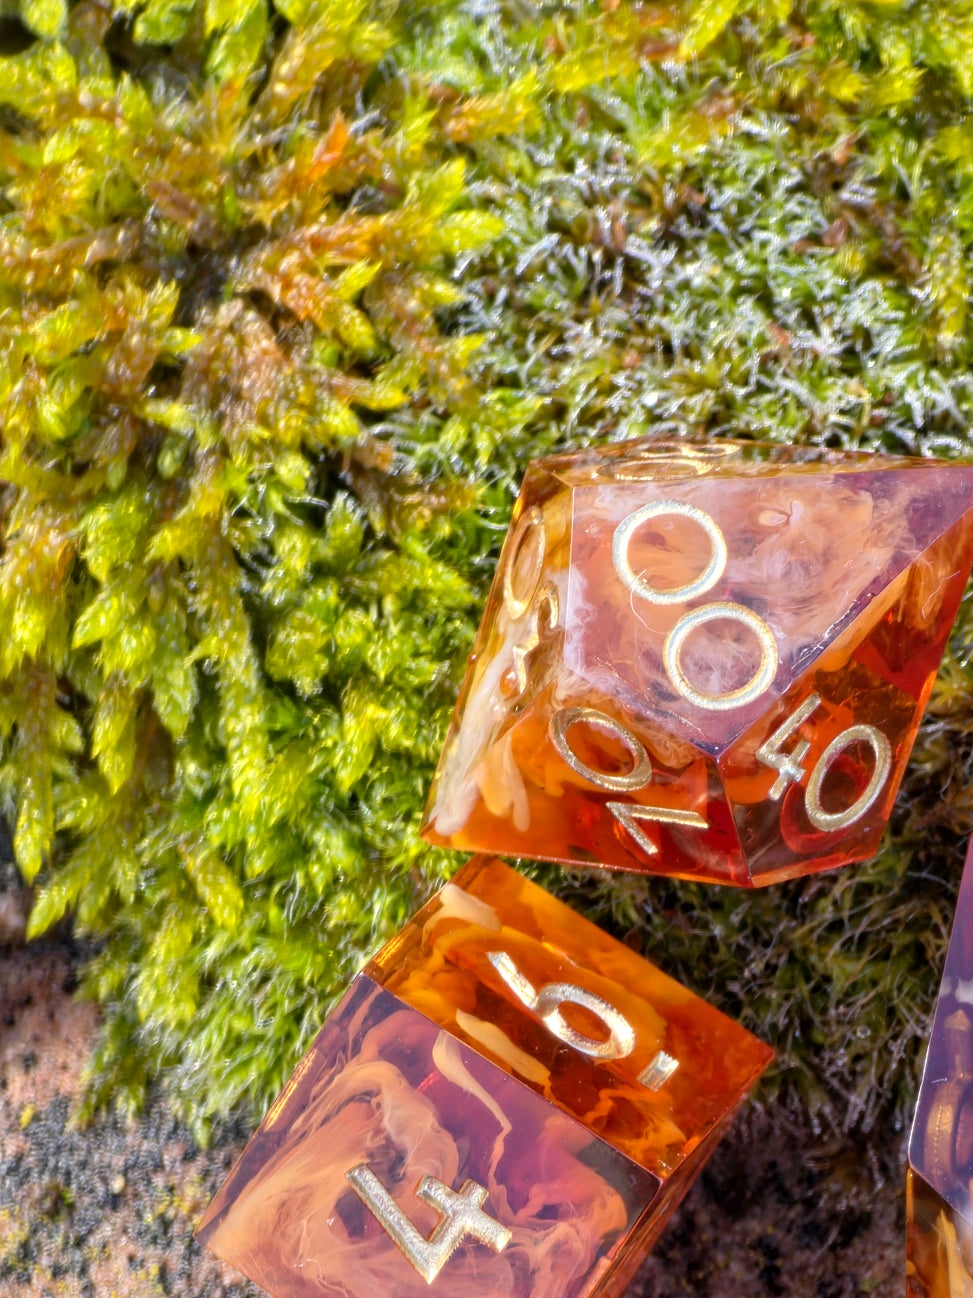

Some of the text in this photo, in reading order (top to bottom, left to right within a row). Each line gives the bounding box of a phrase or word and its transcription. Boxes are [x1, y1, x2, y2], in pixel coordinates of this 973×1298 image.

[612, 499, 779, 710] 00
[548, 706, 709, 855] 70
[756, 693, 892, 833] 40
[344, 1162, 513, 1285] 4
